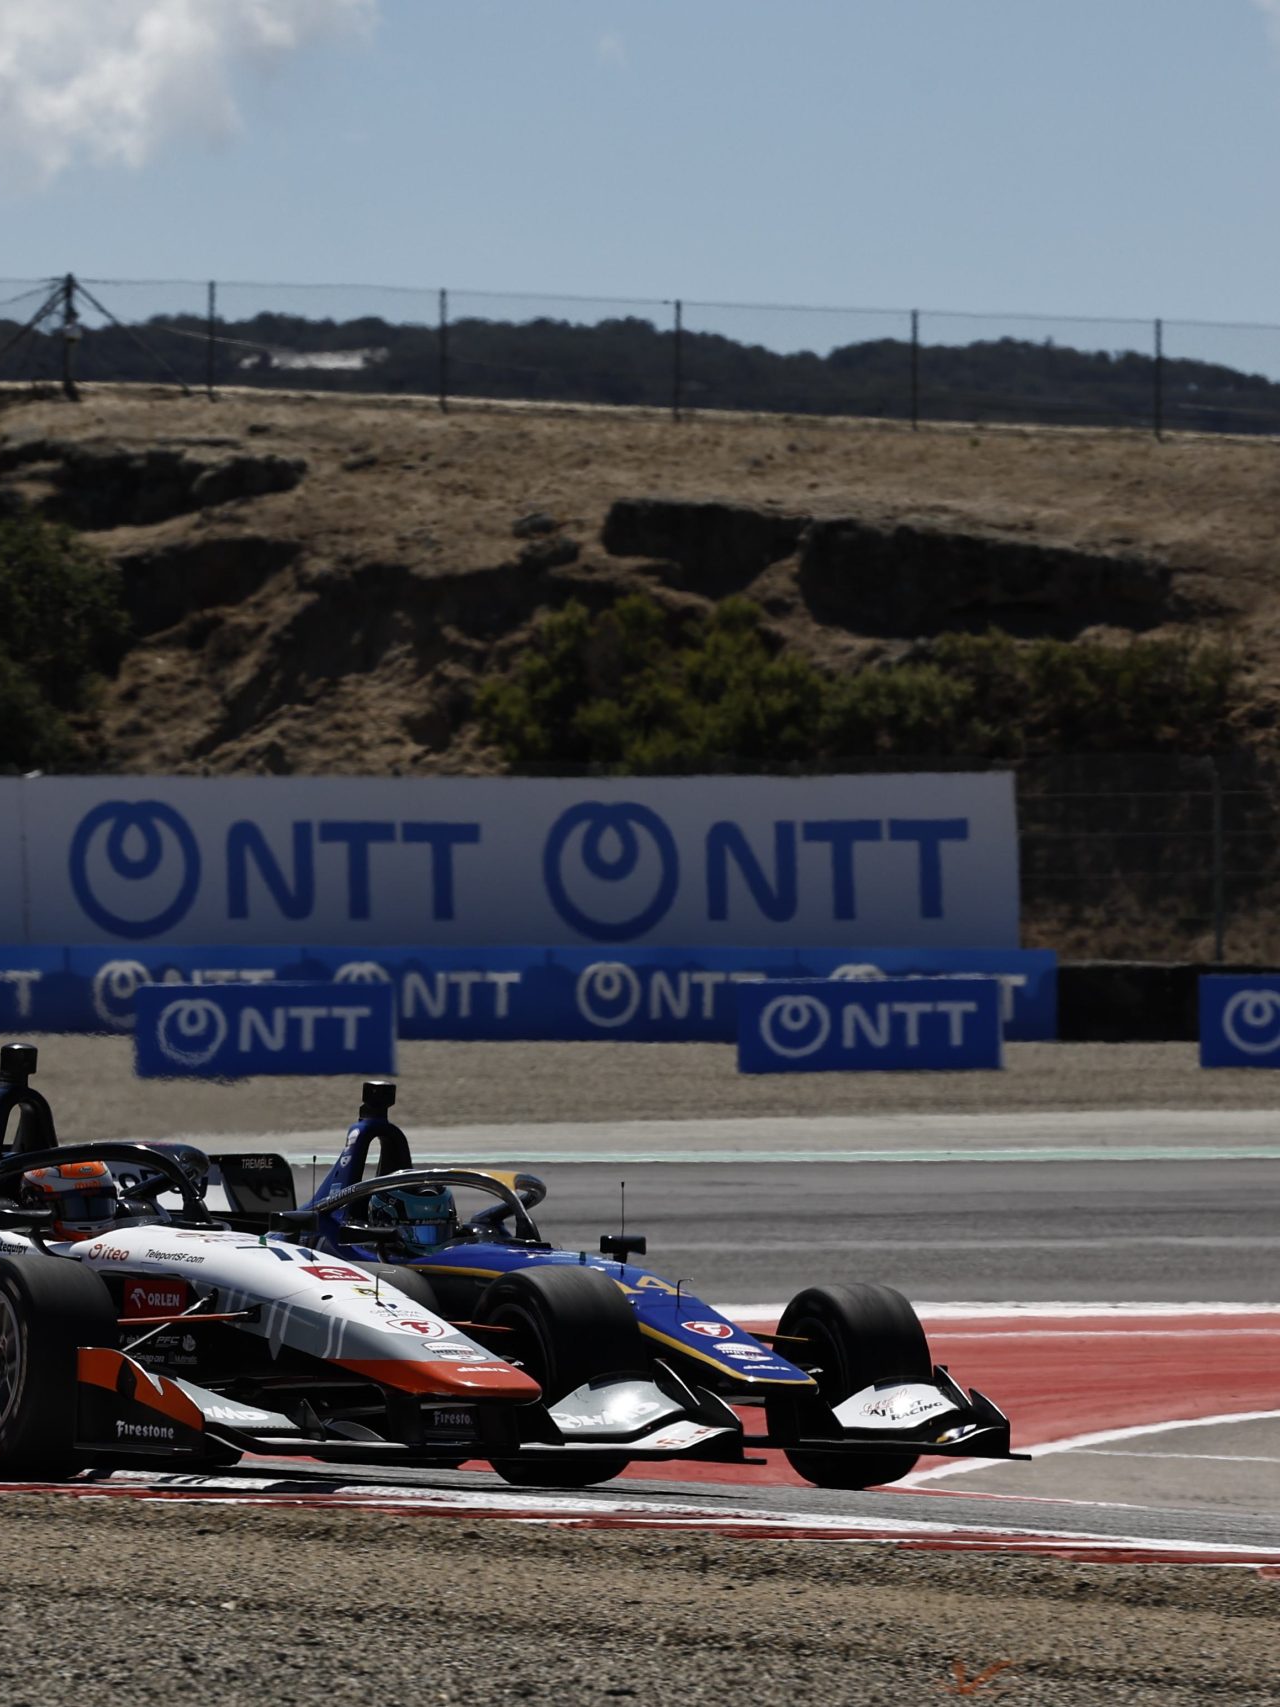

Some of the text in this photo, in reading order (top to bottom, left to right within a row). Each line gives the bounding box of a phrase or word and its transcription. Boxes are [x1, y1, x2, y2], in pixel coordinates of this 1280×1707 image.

[226, 818, 969, 922] NTT NTT
[403, 971, 521, 1018] NTT
[238, 1006, 372, 1052] NTT
[842, 1002, 977, 1048] NTT
[241, 1158, 273, 1169] TREMBLE
[0, 1241, 29, 1255] tequipy
[148, 1292, 180, 1307] ORLEN
[433, 1410, 474, 1426] Firesto
[116, 1419, 175, 1439] Firestone
